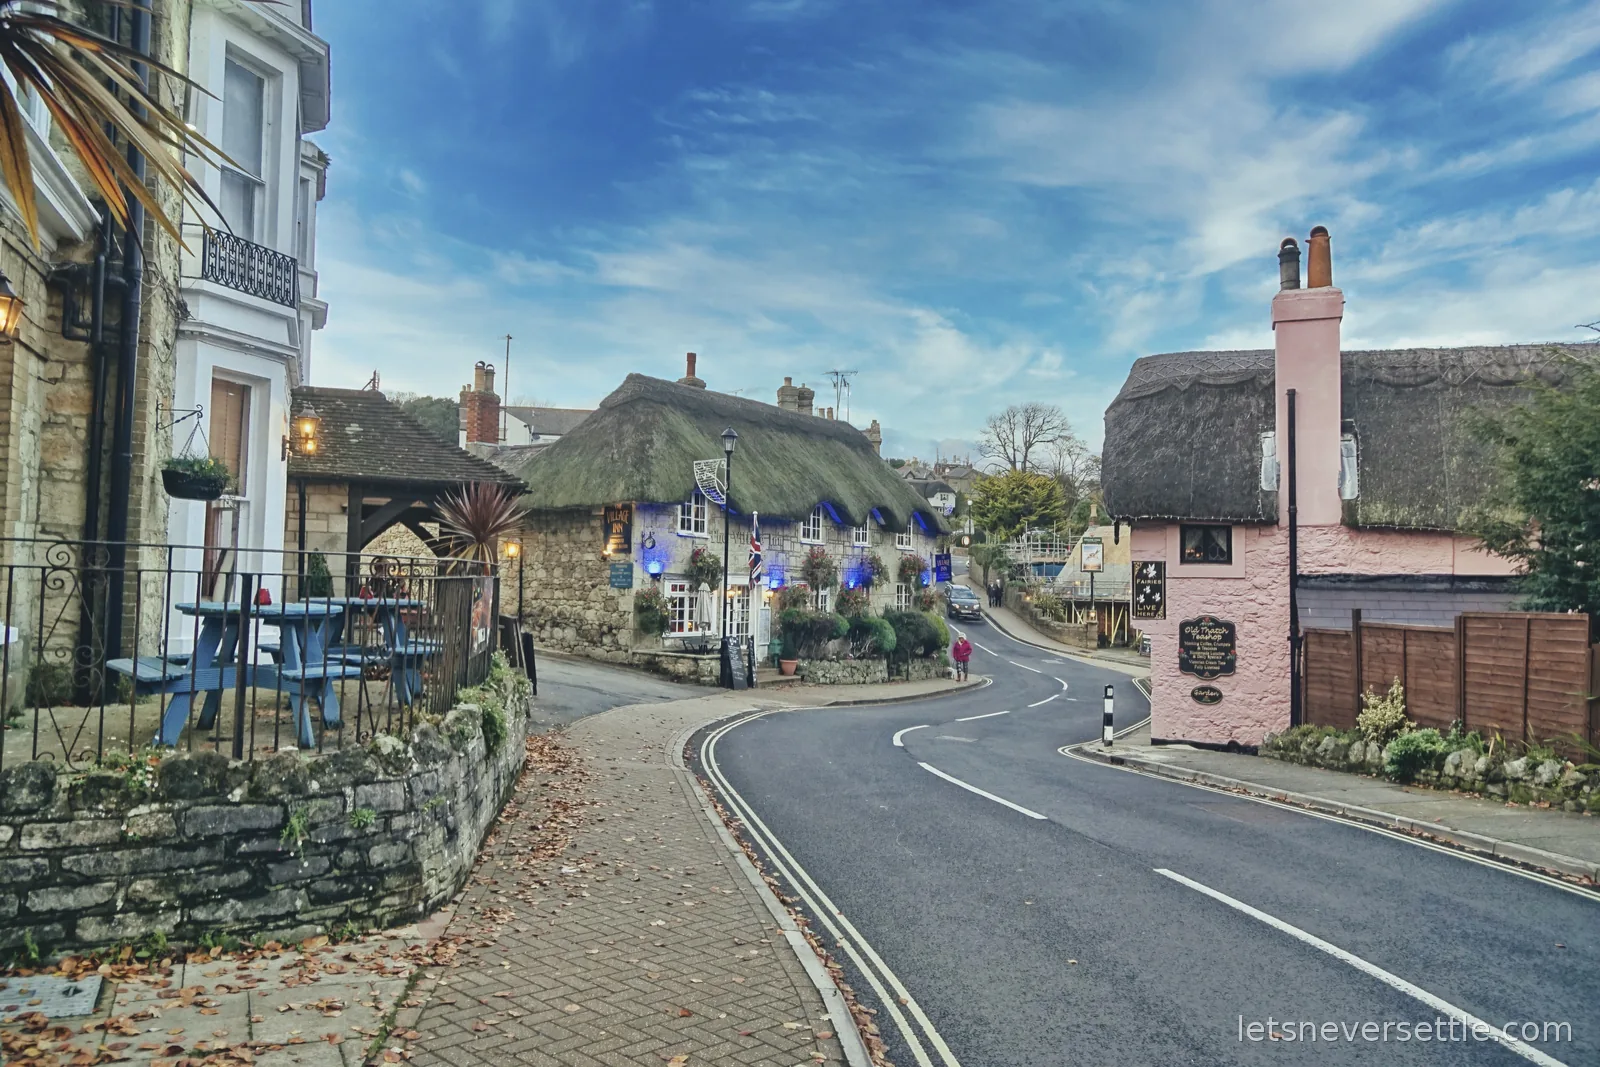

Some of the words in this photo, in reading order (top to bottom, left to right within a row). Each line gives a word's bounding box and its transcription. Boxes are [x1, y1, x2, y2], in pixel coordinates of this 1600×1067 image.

[606, 510, 629, 524] VILLAGE
[612, 522, 623, 533] INN
[1185, 626, 1200, 634] Old
[1201, 626, 1229, 635] Thatch
[1192, 632, 1222, 642] Teashop
